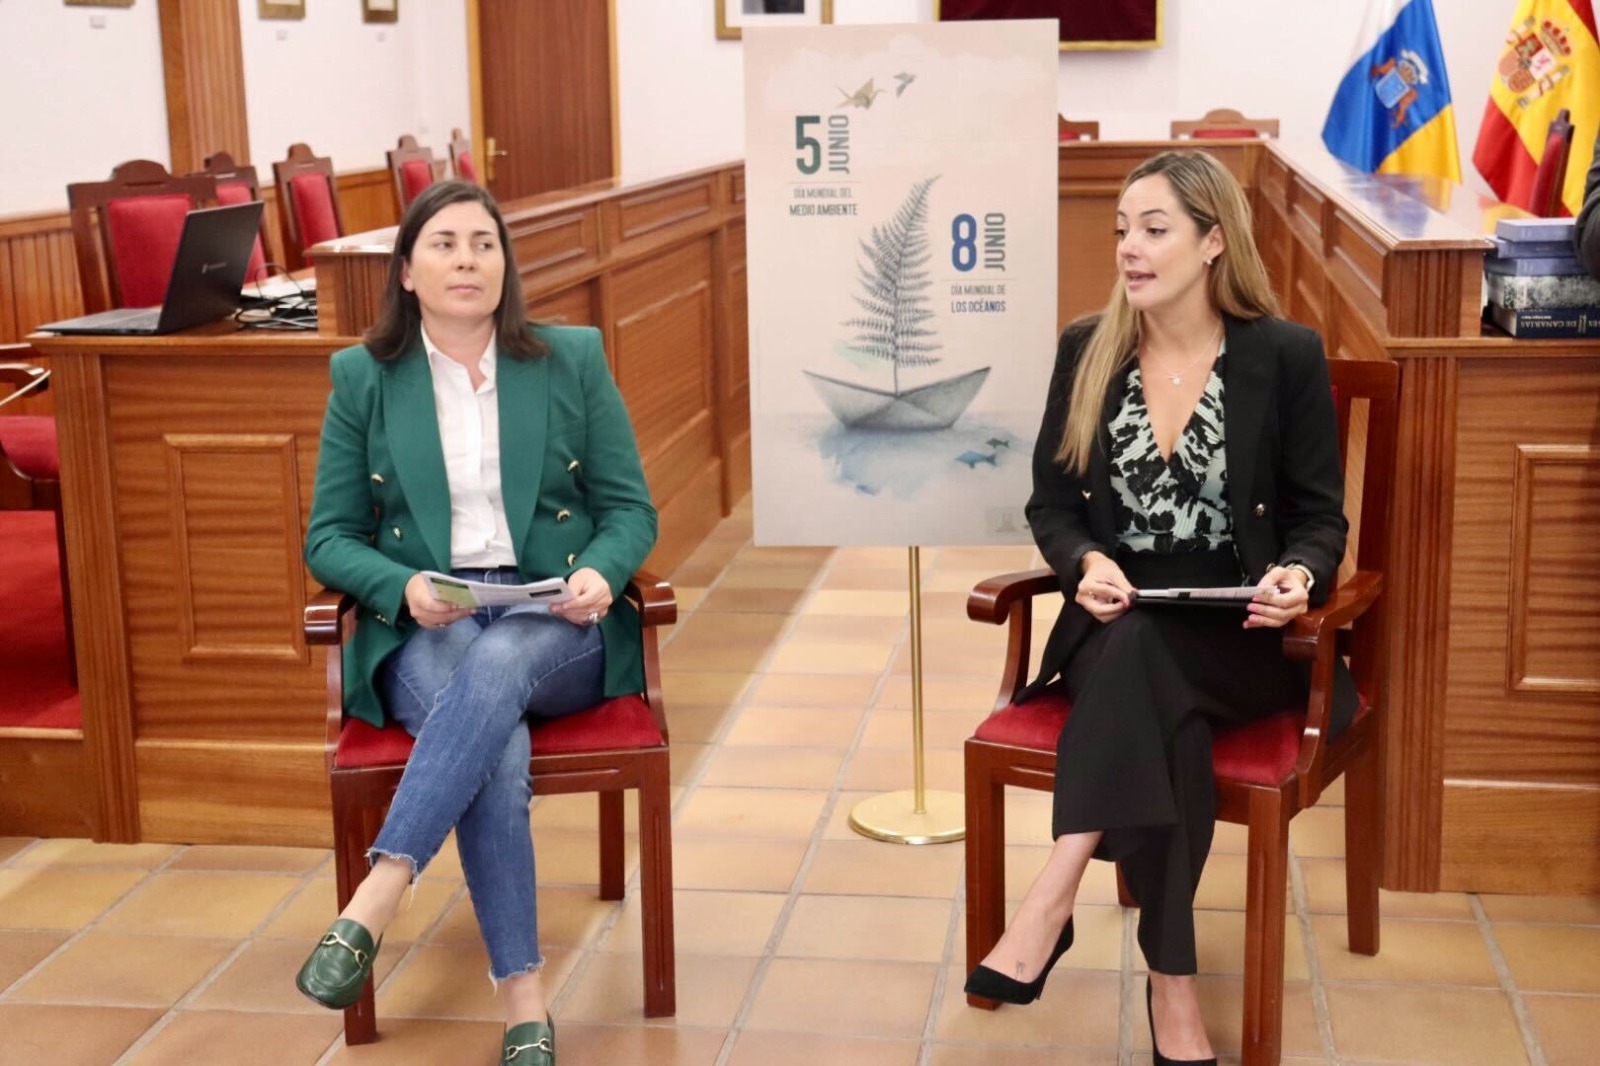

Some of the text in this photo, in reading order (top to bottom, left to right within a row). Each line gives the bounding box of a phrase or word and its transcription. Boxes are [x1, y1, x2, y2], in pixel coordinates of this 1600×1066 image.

[796, 114, 850, 175] 5 JUNIO
[806, 187, 838, 199] MUNDIAL
[839, 187, 853, 198] DEL
[789, 203, 858, 216] MEDIO AMBIENTE
[951, 212, 1006, 272] 8 JUNIO
[951, 283, 1006, 296] DÍA MUNDIAL DE
[950, 298, 1006, 313] LOS OCÉANOS
